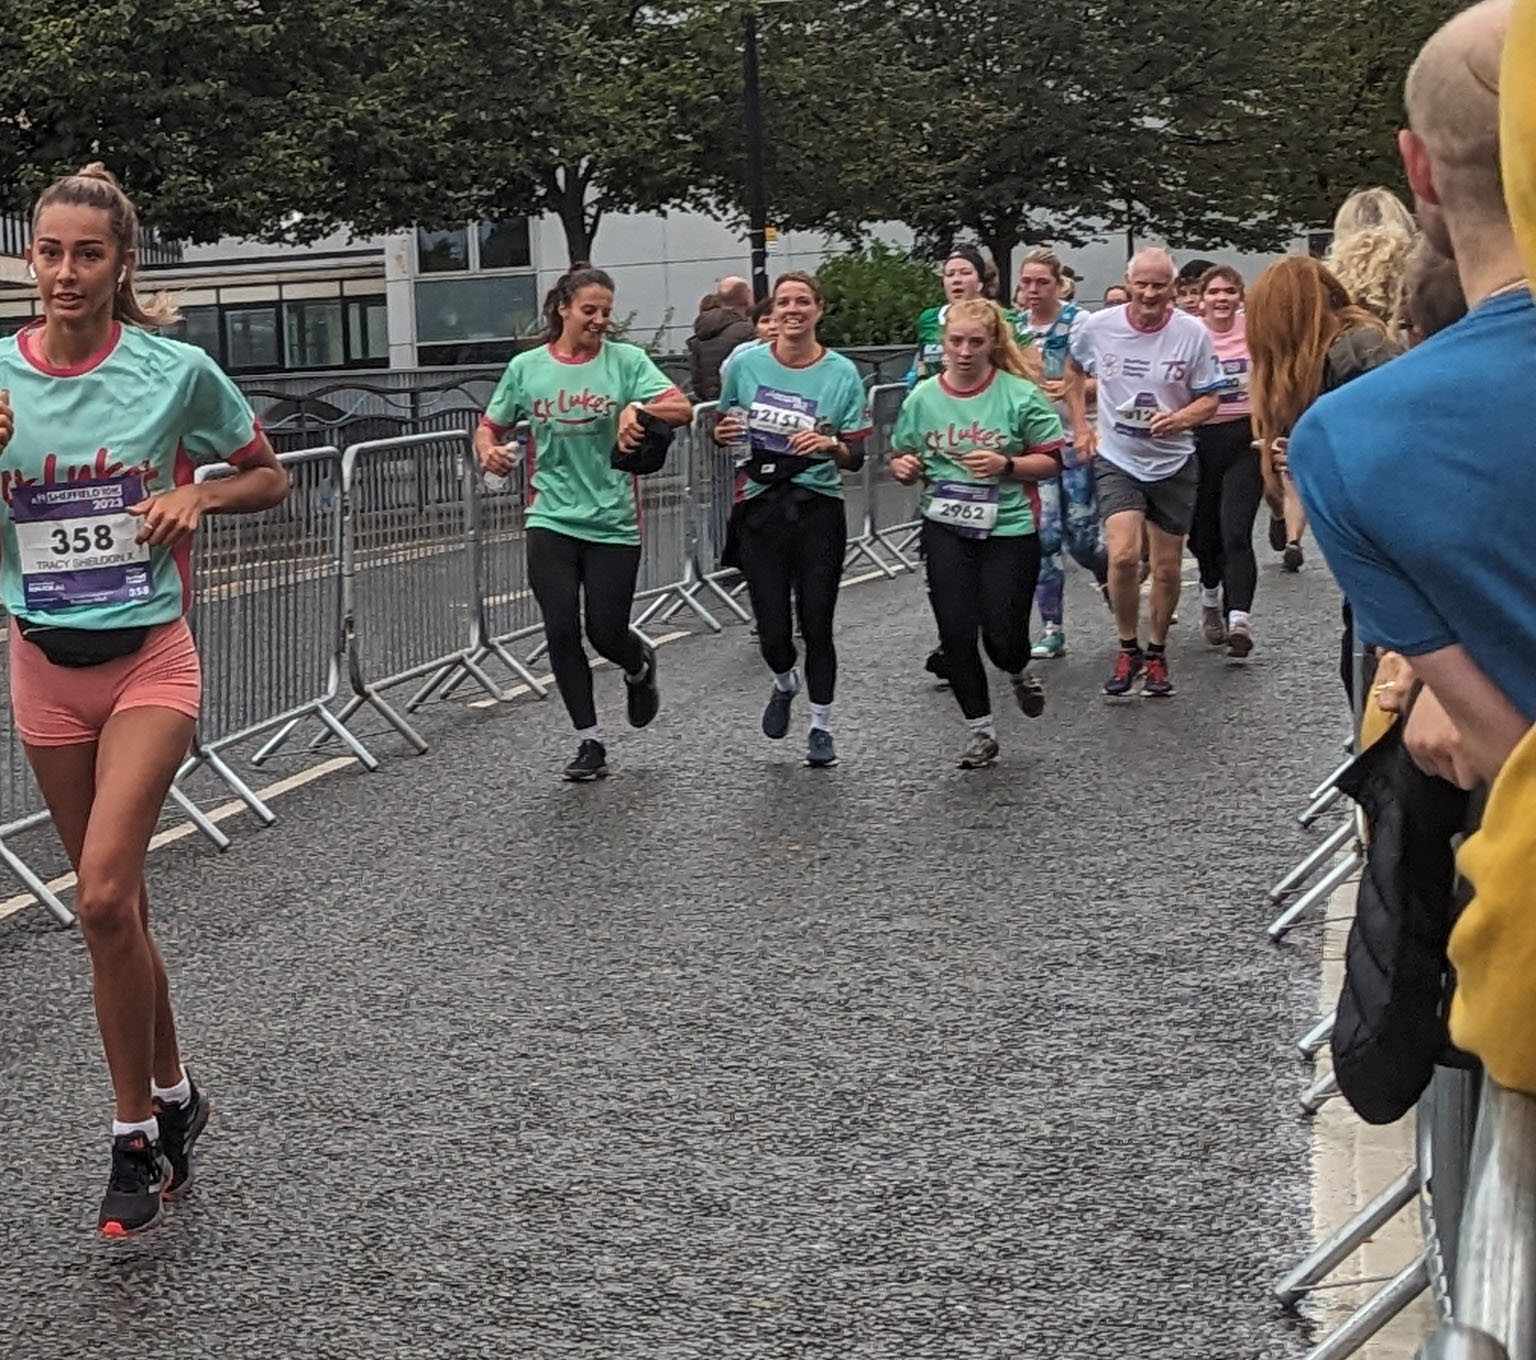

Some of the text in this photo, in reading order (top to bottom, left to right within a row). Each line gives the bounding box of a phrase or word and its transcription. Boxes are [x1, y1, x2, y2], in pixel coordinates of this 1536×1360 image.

[92, 498, 124, 511] 2023
[50, 524, 114, 555] 358
[36, 559, 71, 570] TRACY
